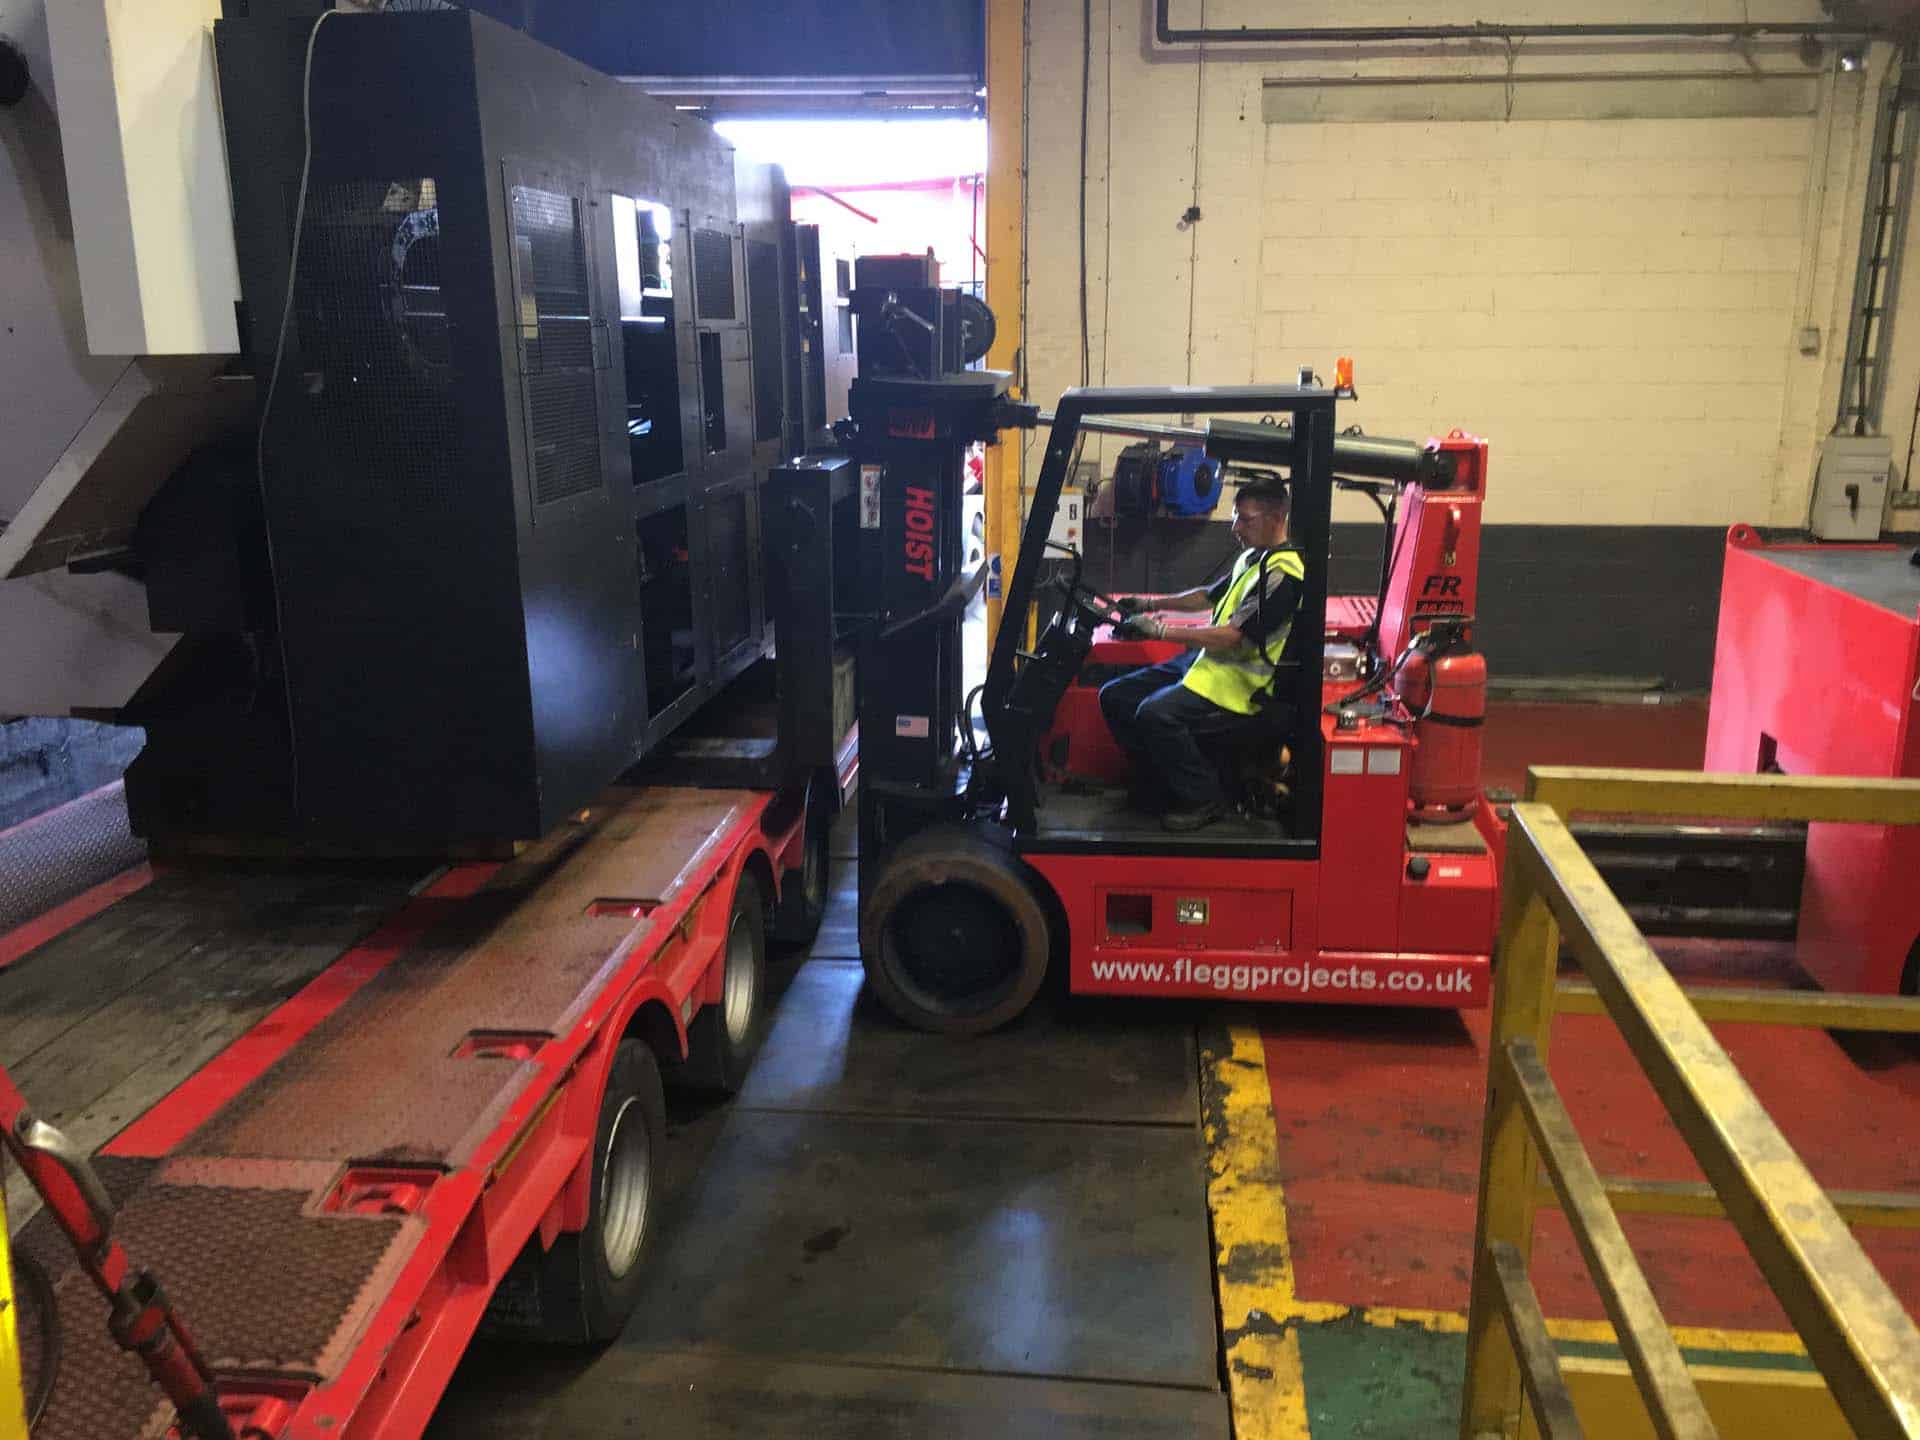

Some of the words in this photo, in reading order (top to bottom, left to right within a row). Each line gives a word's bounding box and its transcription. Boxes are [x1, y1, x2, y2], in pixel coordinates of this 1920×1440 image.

[905, 487, 935, 581] HOIST
[1422, 576, 1461, 595] FR
[1091, 959, 1472, 993] www.fleggprojects.co.uk
